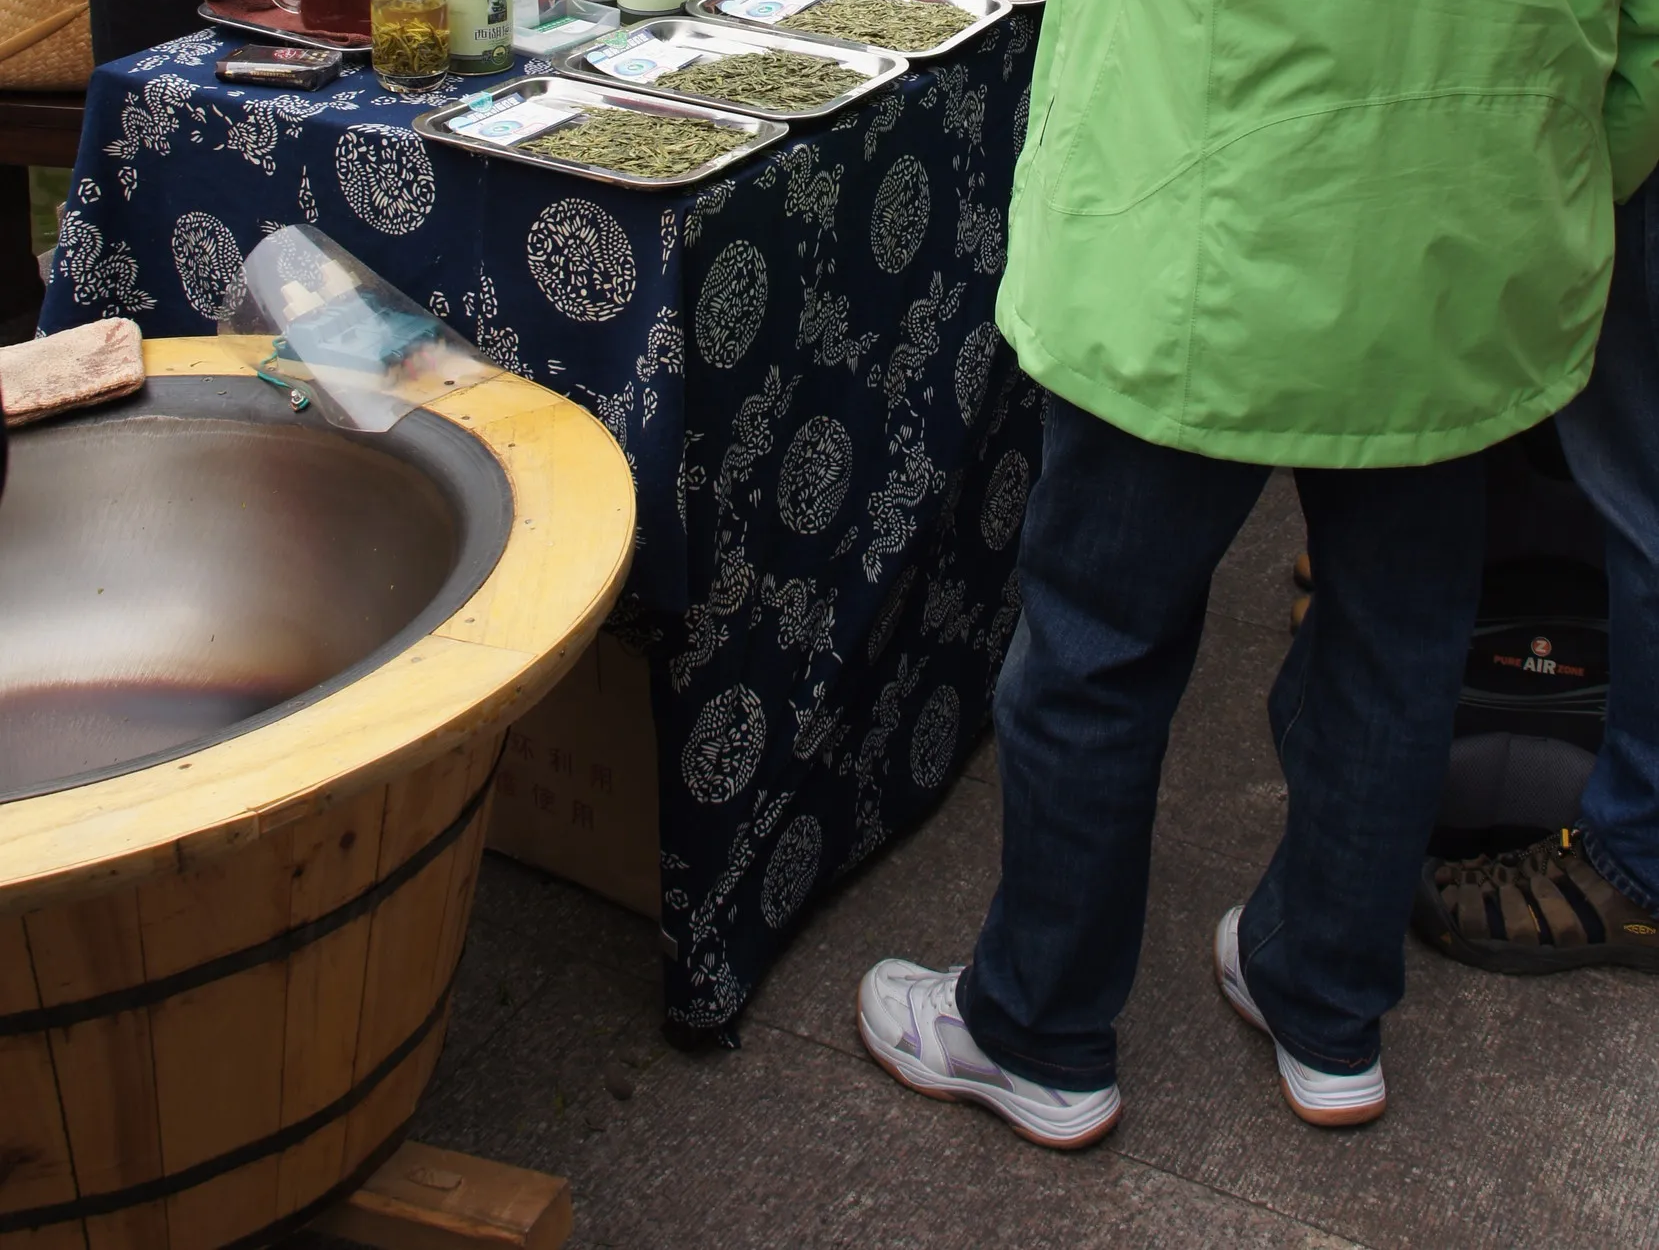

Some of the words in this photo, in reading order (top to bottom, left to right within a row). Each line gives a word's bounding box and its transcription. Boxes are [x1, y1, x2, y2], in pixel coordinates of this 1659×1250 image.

[1493, 655, 1522, 668] PURE
[1523, 656, 1557, 676] AIR
[1557, 664, 1585, 677] ZONE
